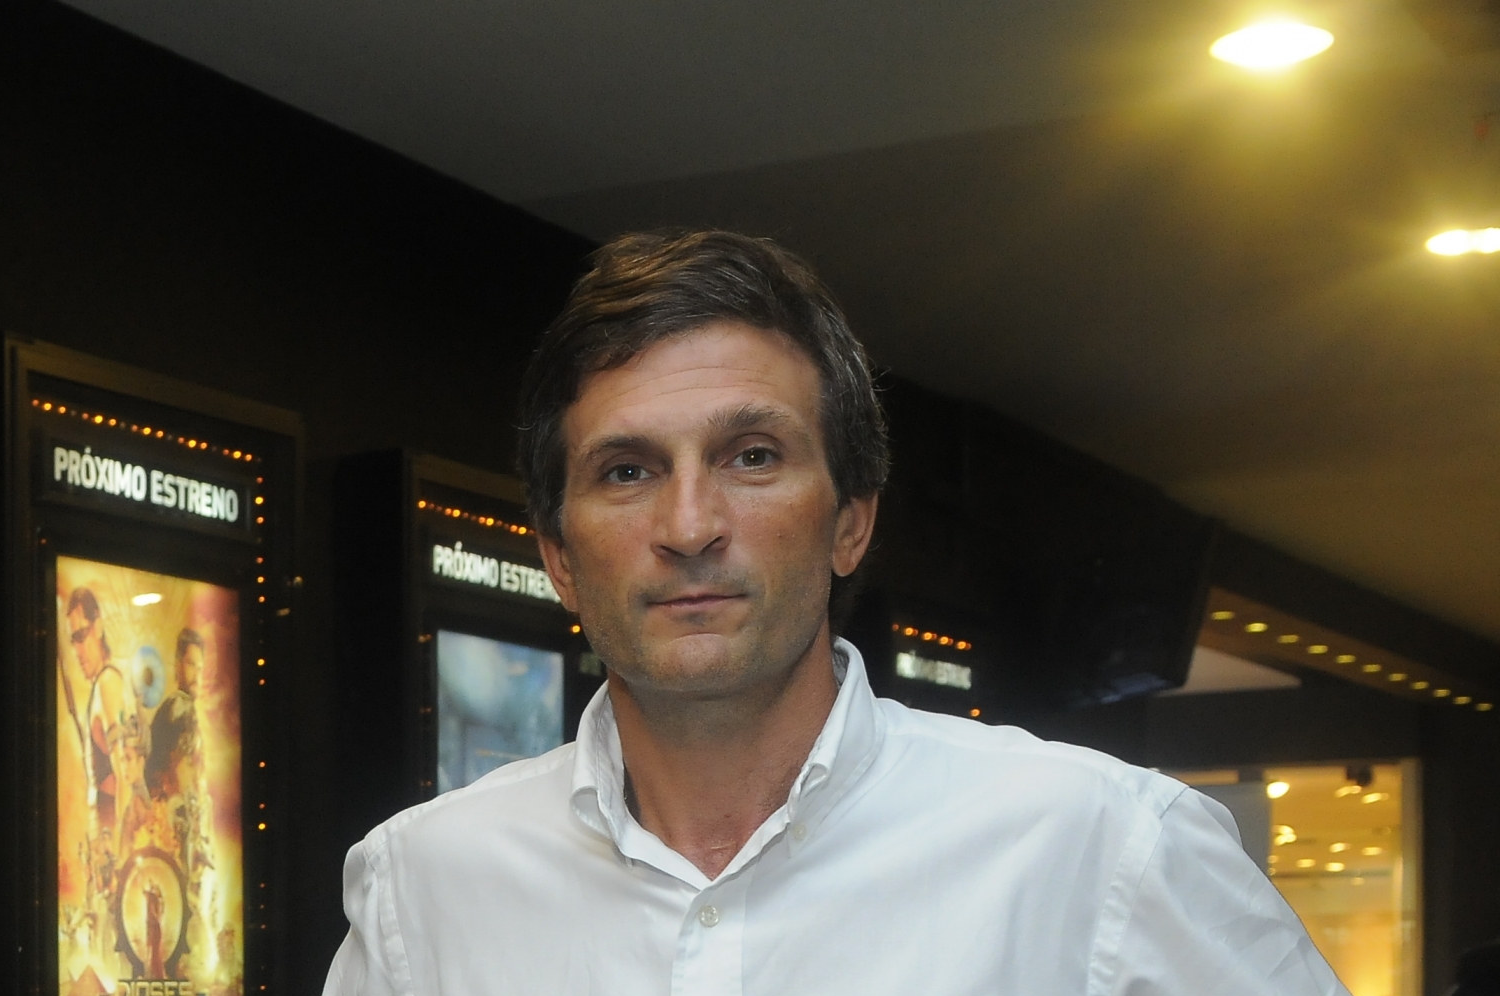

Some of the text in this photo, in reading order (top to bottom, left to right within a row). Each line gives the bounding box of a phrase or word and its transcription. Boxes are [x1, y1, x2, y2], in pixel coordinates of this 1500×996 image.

[53, 446, 239, 523] PRÓXIMO ESTRENO
[433, 541, 499, 588] PRÓXIMO
